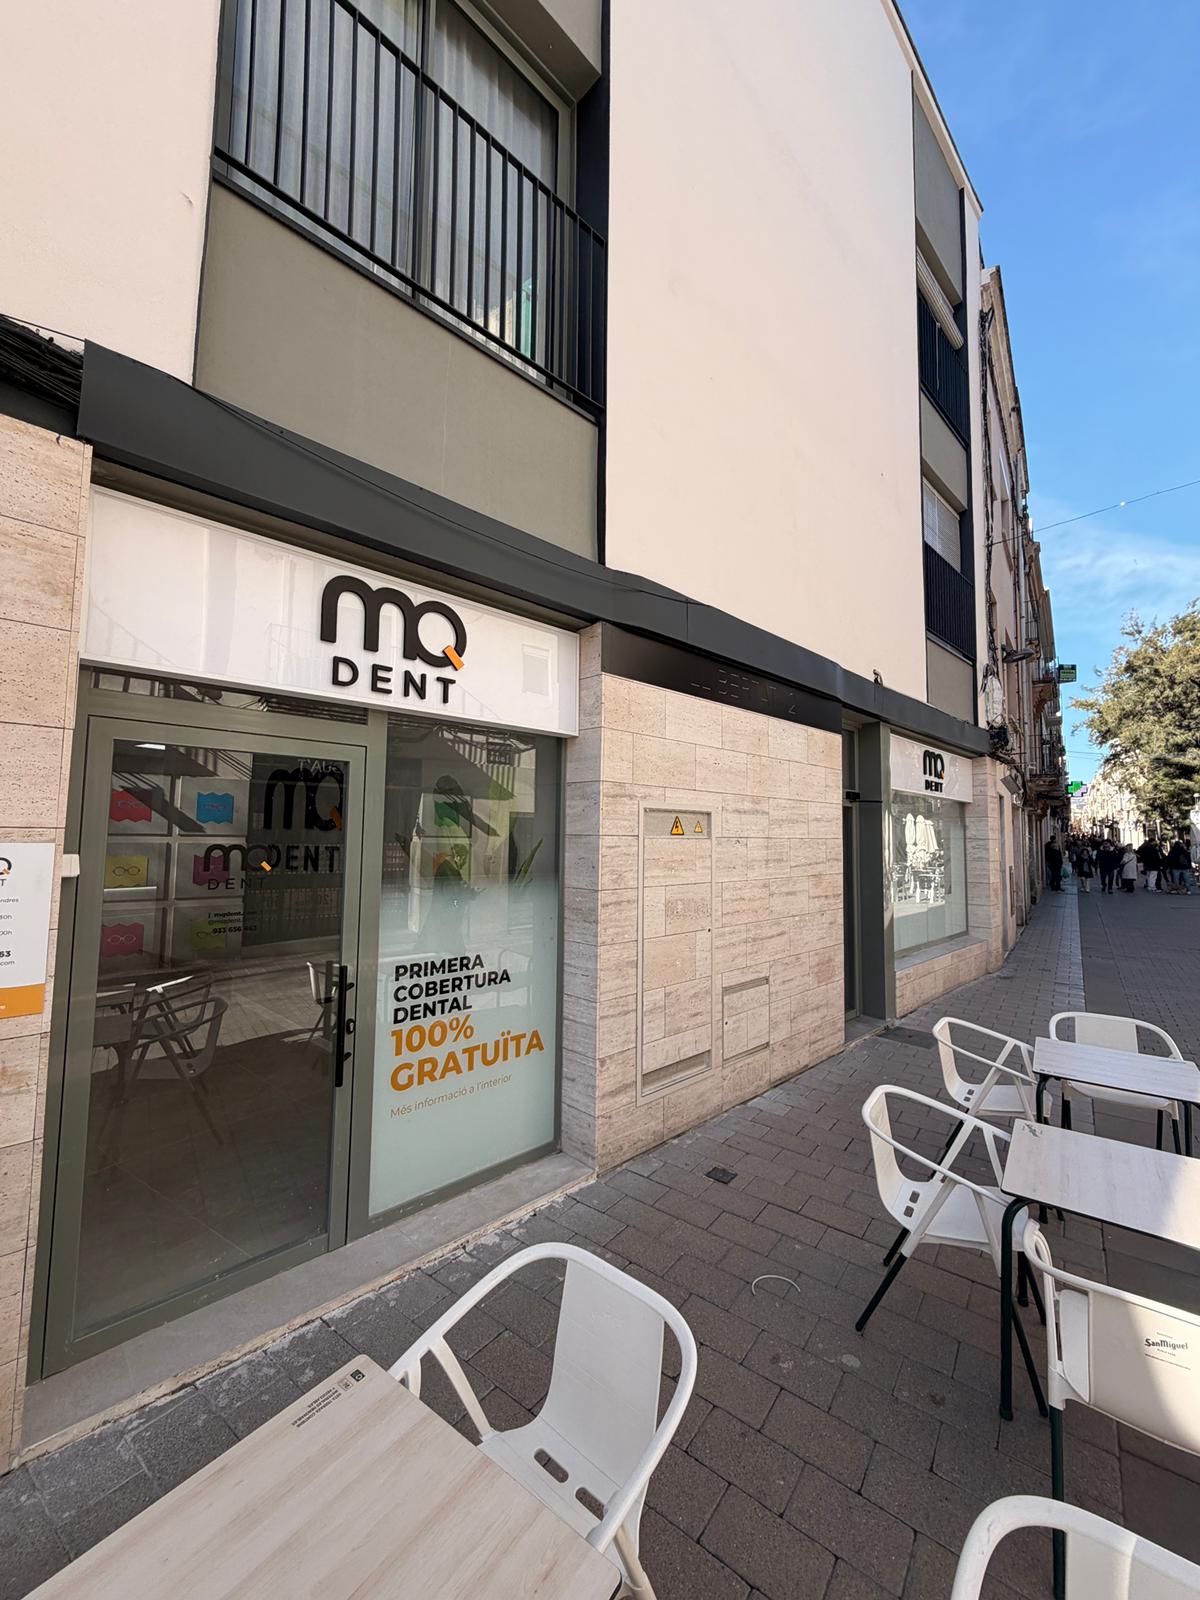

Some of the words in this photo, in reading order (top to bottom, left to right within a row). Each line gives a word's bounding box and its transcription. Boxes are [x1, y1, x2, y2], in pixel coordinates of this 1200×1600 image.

[332, 656, 456, 704] DENT
[925, 779, 943, 792] DENT
[207, 877, 265, 891] DENT
[395, 954, 484, 981] PRIMERA
[393, 969, 511, 1003] COBERTURA
[393, 995, 473, 1024] DENTAL
[391, 1014, 475, 1056] 100%
[390, 1030, 545, 1092] GRATUÏTA
[390, 1104, 413, 1118] Més
[414, 1085, 468, 1111] informació
[469, 1085, 475, 1094] a
[476, 1073, 512, 1091] l'interior
